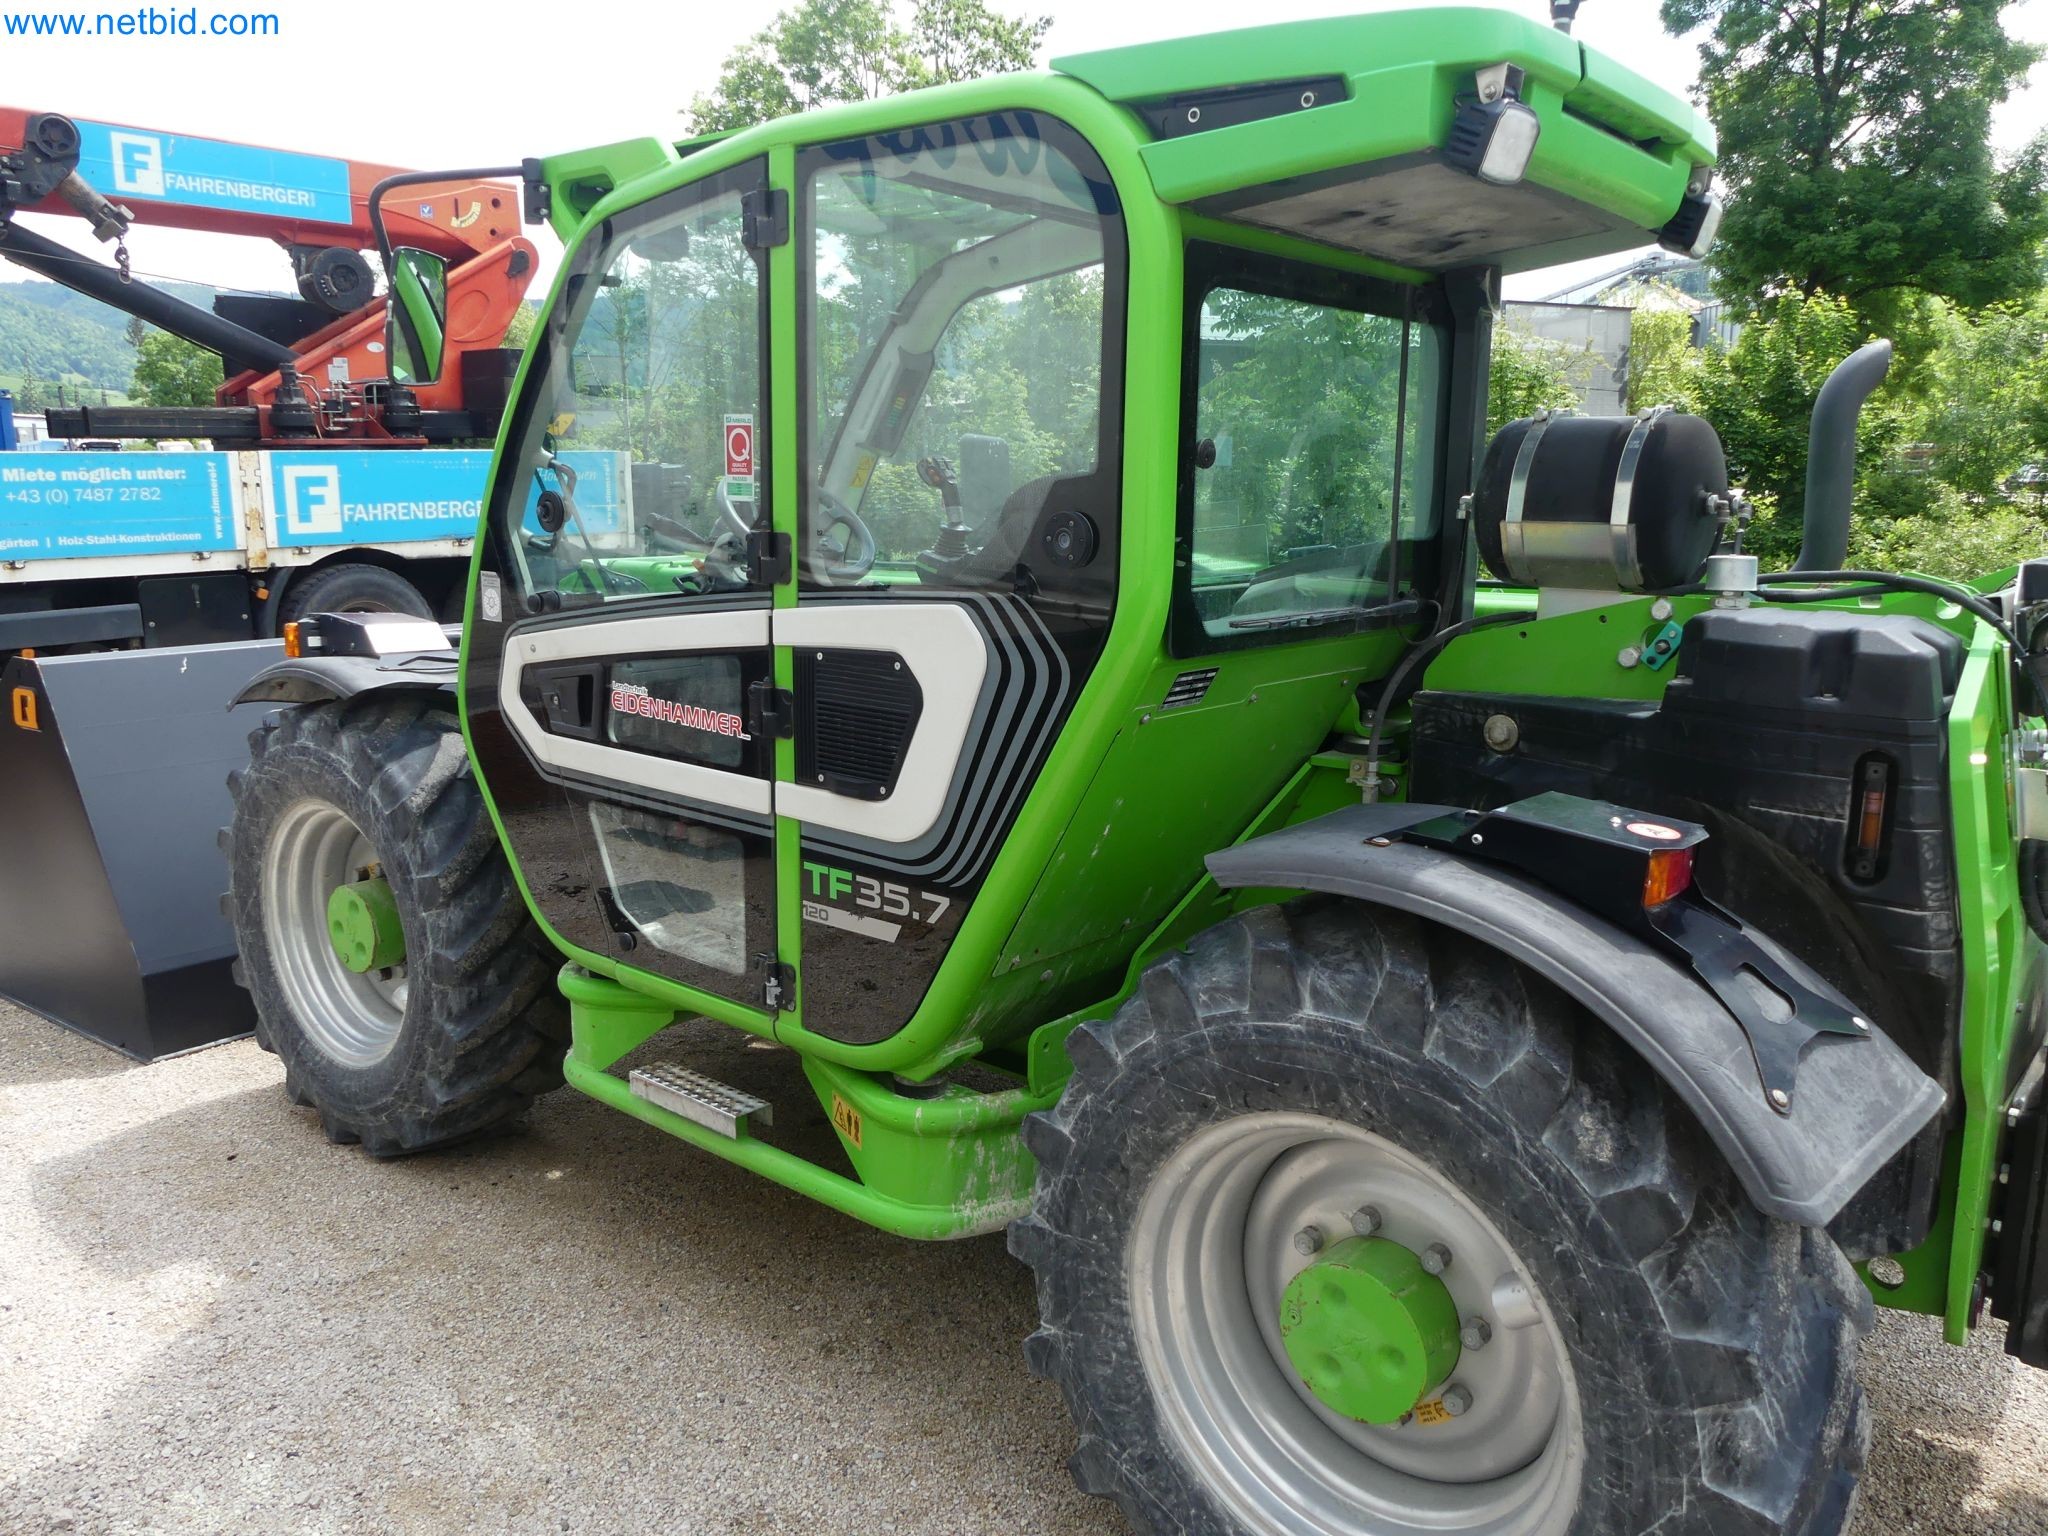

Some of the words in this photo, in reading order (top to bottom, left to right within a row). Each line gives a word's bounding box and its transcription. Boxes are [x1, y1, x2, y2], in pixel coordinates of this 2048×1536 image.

[165, 173, 310, 206] FAHRENBERGER
[728, 427, 750, 462] Q
[3, 468, 56, 482] Miete
[61, 467, 127, 484] möglich
[136, 468, 186, 481] unter:
[6, 489, 40, 503] +43
[46, 489, 69, 505] (0)
[75, 488, 113, 502] 7487
[119, 487, 161, 501] 2782
[58, 532, 201, 546] Holz-Stahl-Konstruktionen
[613, 681, 648, 696] Landtechnik
[611, 690, 743, 738] EIDENHAMMER
[803, 904, 829, 922] 120
